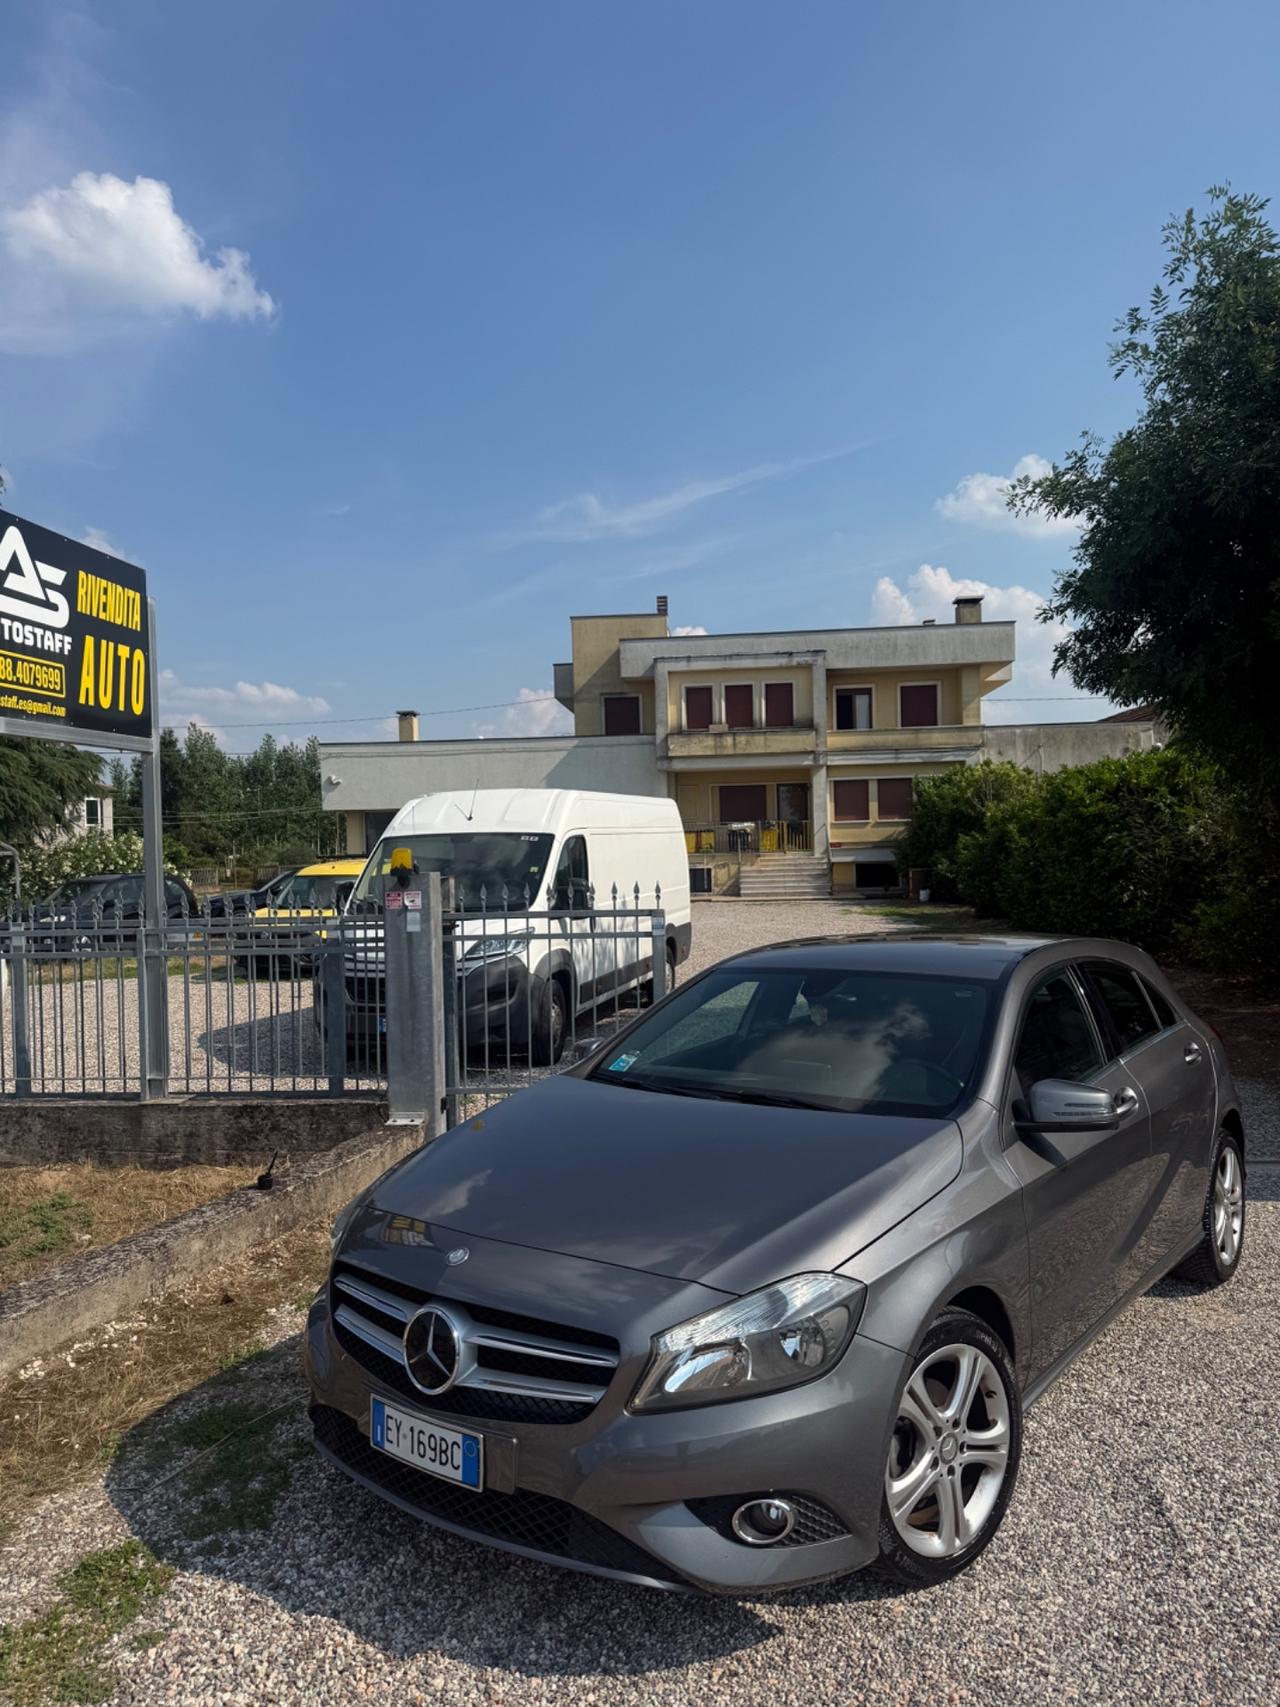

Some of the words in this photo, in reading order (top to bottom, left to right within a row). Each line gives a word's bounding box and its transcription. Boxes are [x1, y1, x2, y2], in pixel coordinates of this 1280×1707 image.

[77, 569, 141, 632] RIVENDITA
[0, 617, 72, 655] TOSTAFF
[79, 635, 146, 716] AUTO
